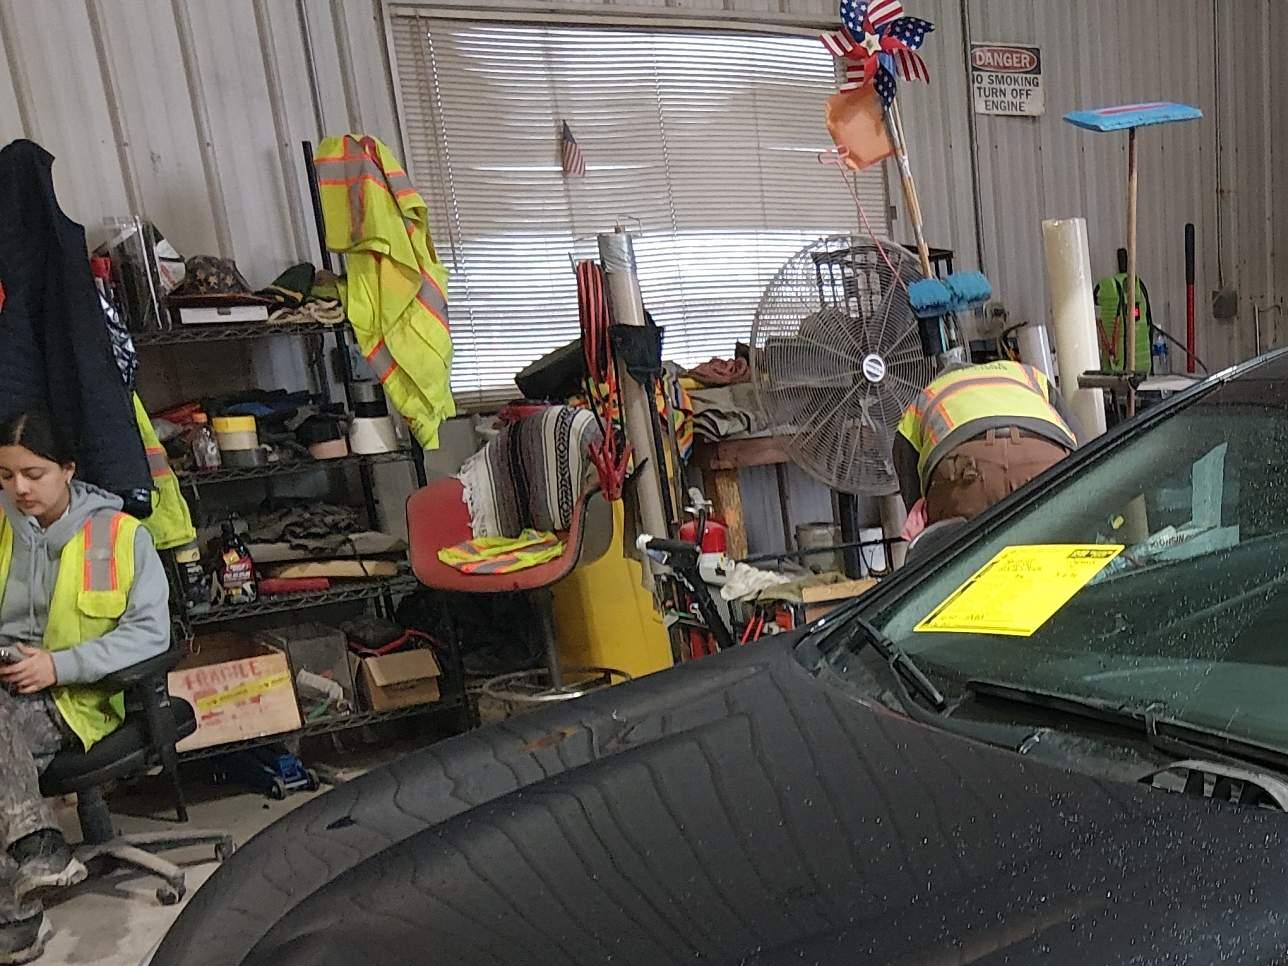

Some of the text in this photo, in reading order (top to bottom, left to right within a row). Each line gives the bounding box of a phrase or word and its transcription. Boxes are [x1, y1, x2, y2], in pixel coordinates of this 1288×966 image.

[975, 51, 1030, 68] DANGER
[988, 75, 1039, 88] SMOKING
[977, 87, 1032, 100] TURN OFF
[985, 100, 1025, 112] ENGINE
